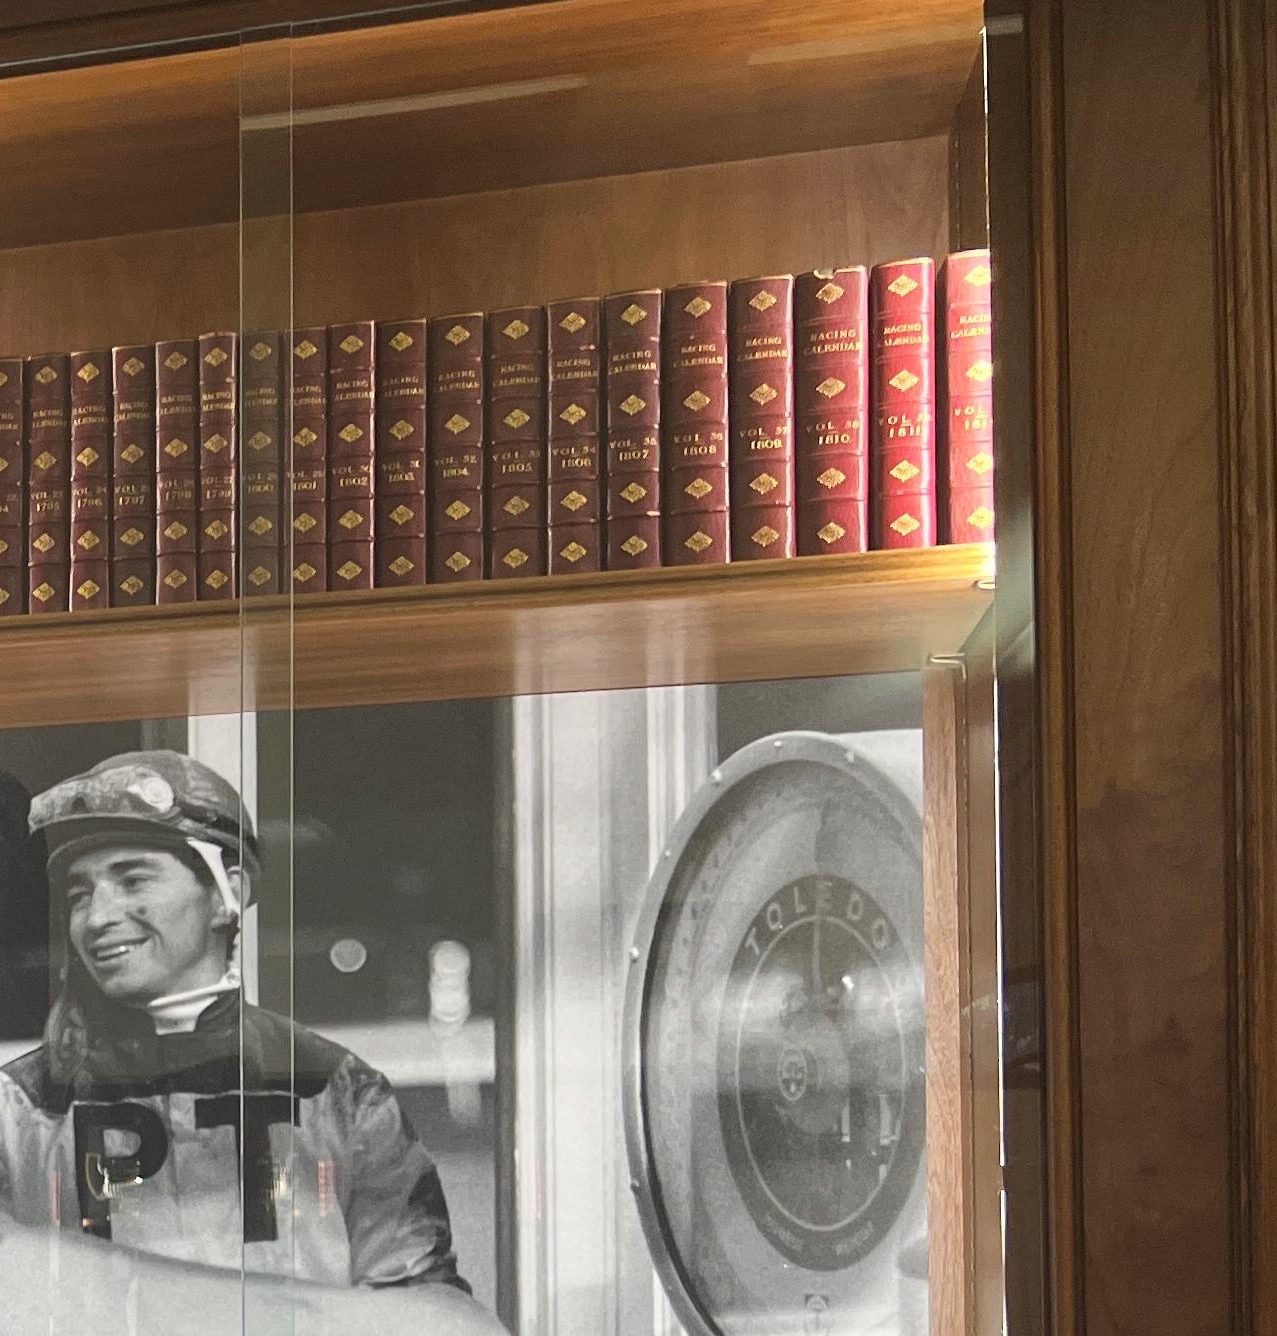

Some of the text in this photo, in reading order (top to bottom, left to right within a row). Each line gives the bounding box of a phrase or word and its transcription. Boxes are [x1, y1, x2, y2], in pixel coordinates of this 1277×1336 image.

[884, 323, 922, 334] RACING
[810, 329, 857, 341] RACING
[964, 418, 987, 430] 181
[818, 434, 851, 445] 1810
[619, 450, 650, 461] 1807
[684, 445, 717, 456] 1808
[744, 879, 891, 956] TOLEDO
